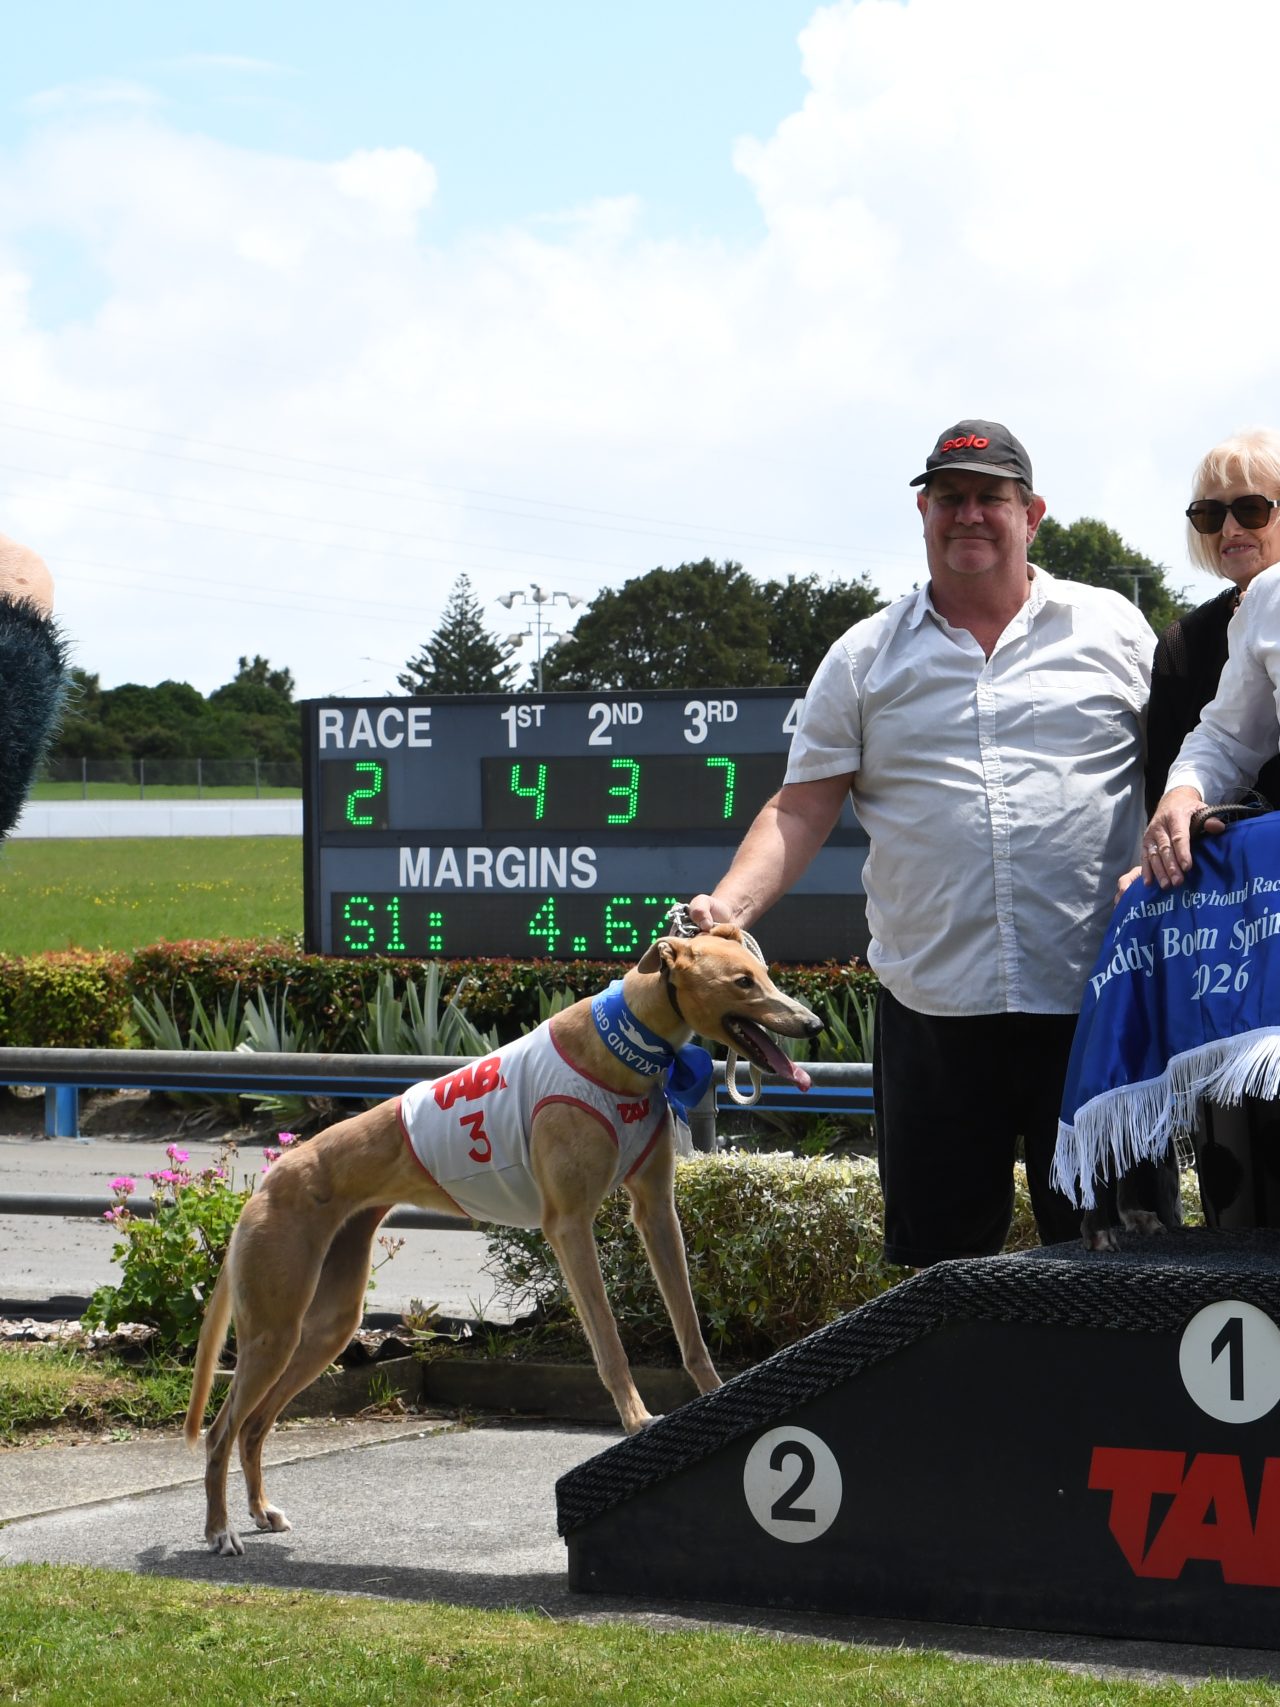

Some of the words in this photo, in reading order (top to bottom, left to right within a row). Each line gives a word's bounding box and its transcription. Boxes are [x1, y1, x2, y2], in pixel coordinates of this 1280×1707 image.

[319, 707, 432, 749] RACE
[501, 704, 545, 749] 1ST
[588, 702, 643, 746] 2ND
[683, 700, 738, 744] 3RD
[346, 762, 383, 825] 2
[510, 764, 547, 820] 4
[608, 758, 640, 824] 3
[707, 757, 735, 819] 7
[400, 846, 598, 889] MARGINS
[1112, 895, 1174, 943] Ackland
[1182, 882, 1249, 909] Greyhound
[459, 1110, 492, 1163] 3
[1209, 1317, 1245, 1401] 1
[769, 1440, 817, 1523] 2
